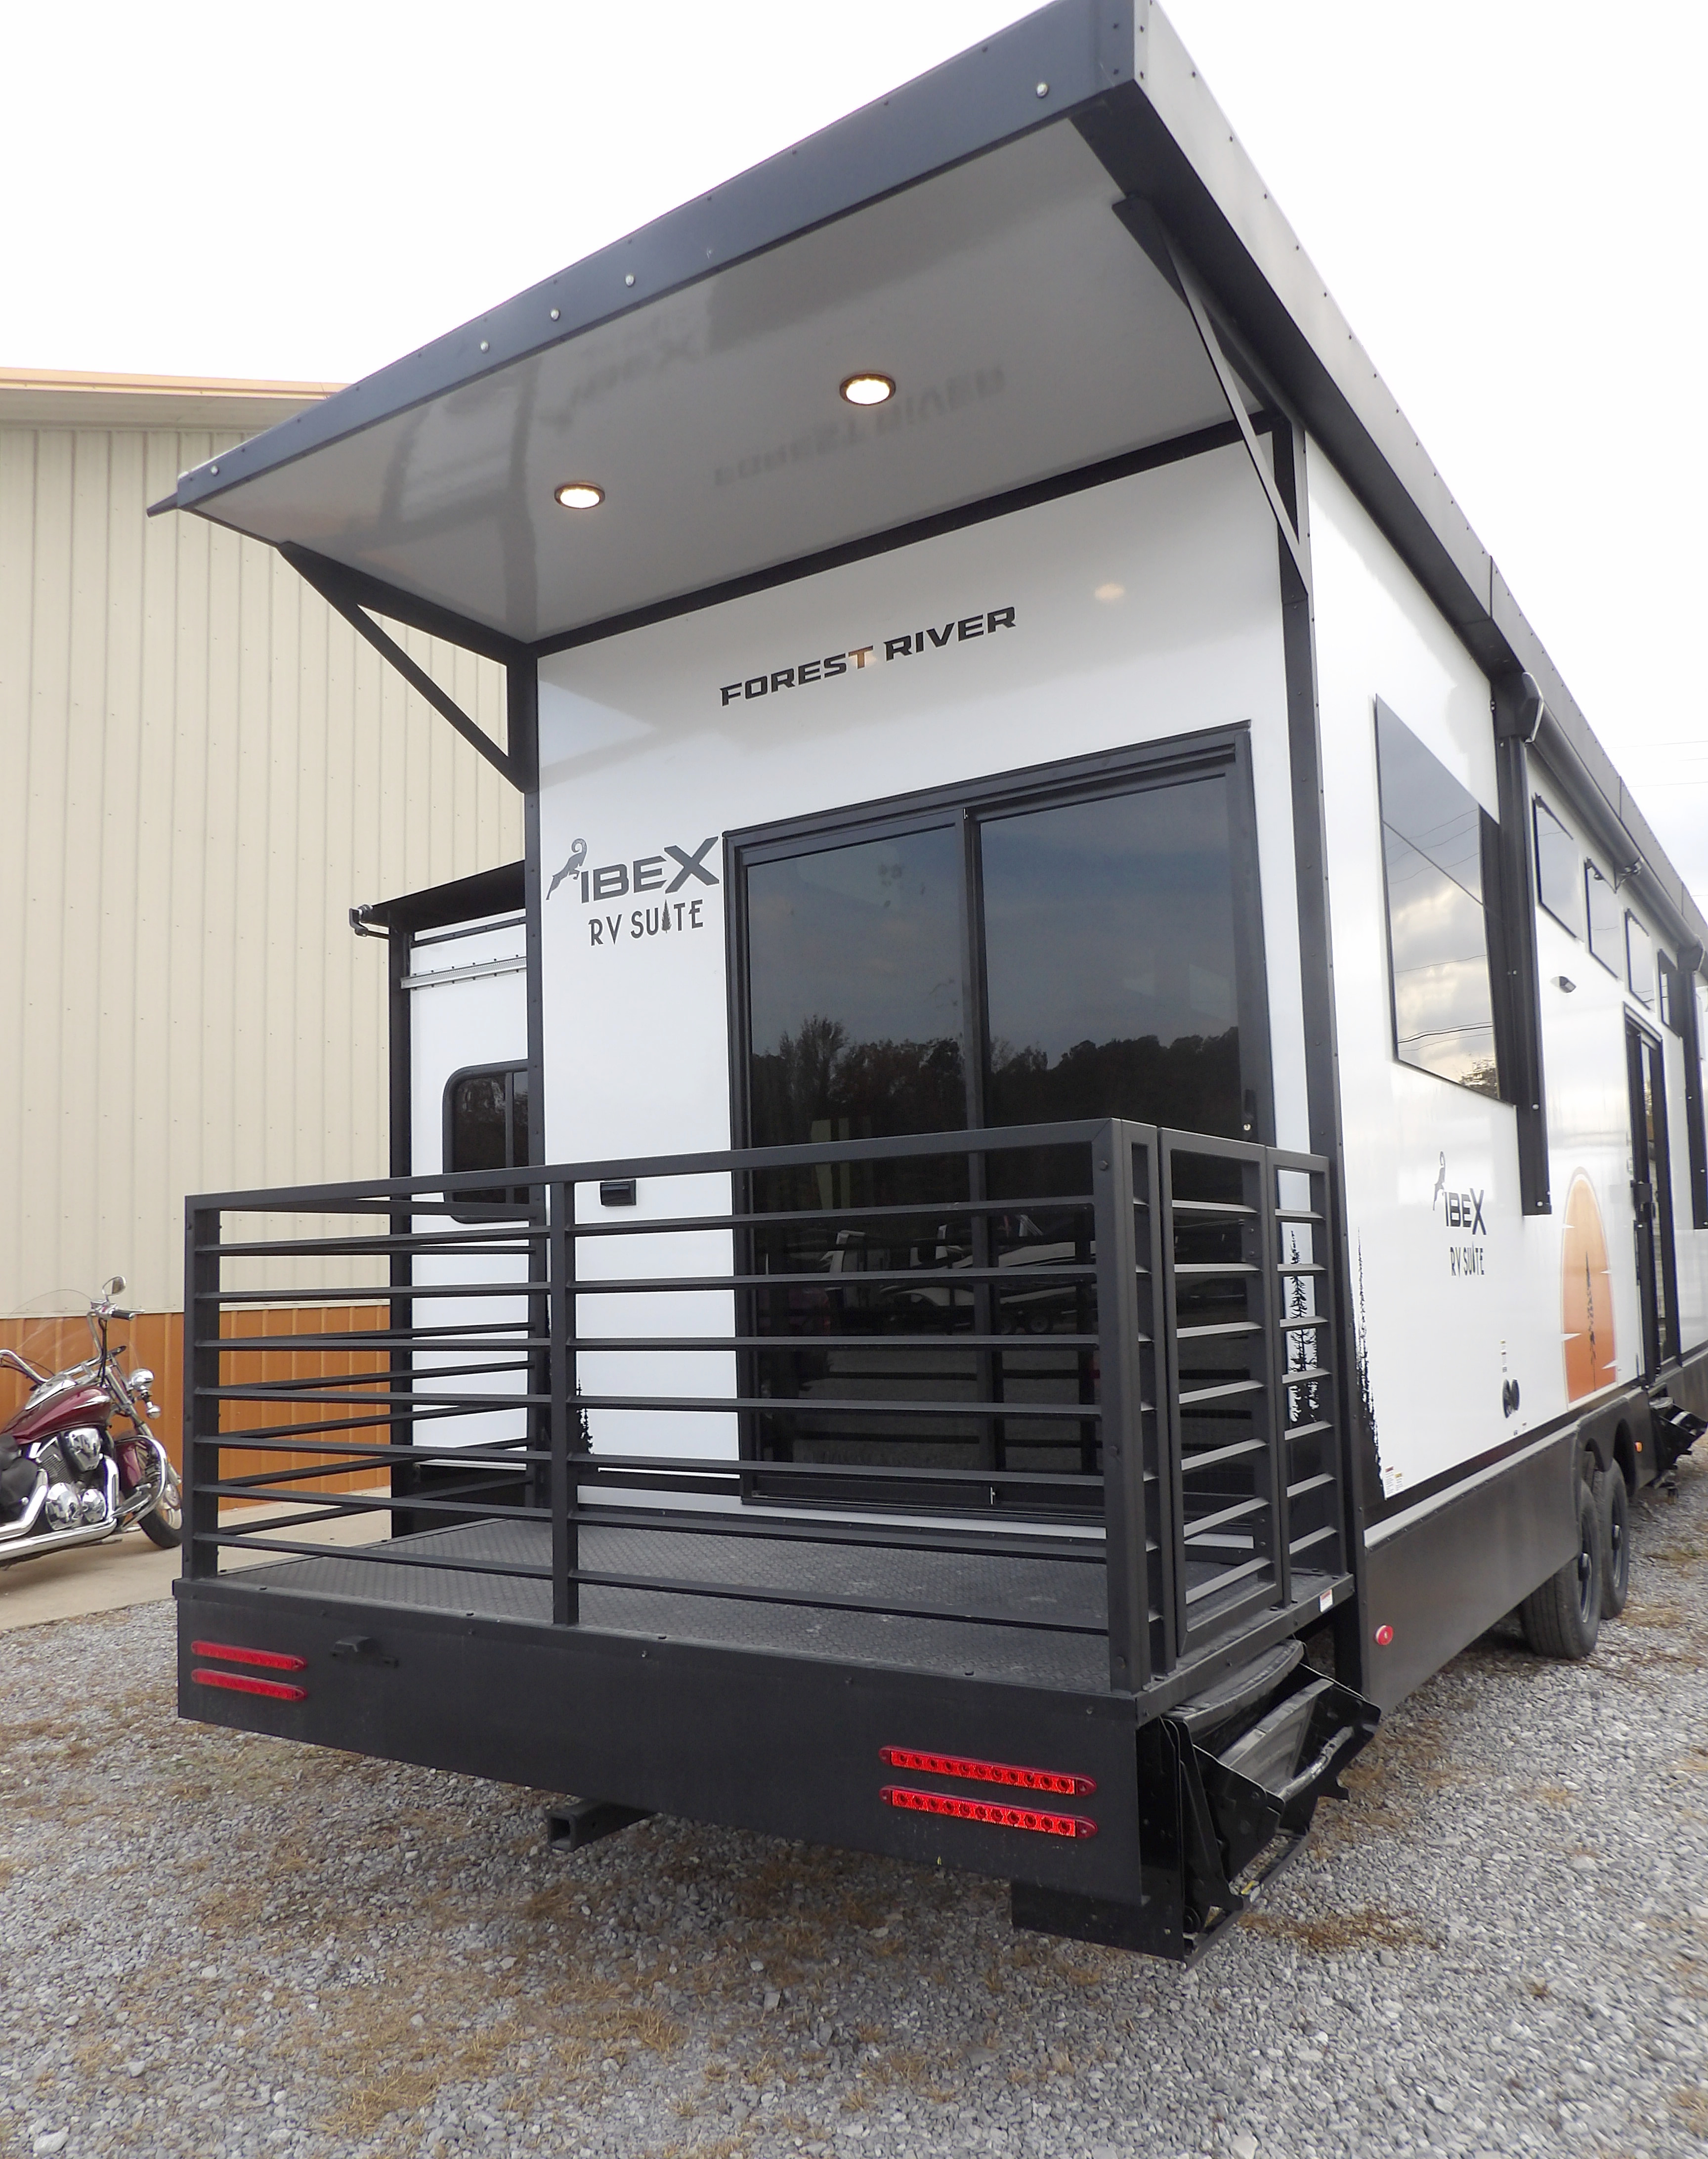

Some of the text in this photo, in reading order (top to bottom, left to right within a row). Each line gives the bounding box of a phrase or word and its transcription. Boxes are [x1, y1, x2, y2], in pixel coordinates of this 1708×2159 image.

[719, 606, 1017, 707] FOREST RIVER
[581, 836, 720, 904] IBEX
[588, 914, 622, 946] RV
[1444, 1188, 1487, 1235] IBEX
[1450, 1247, 1461, 1277] RV
